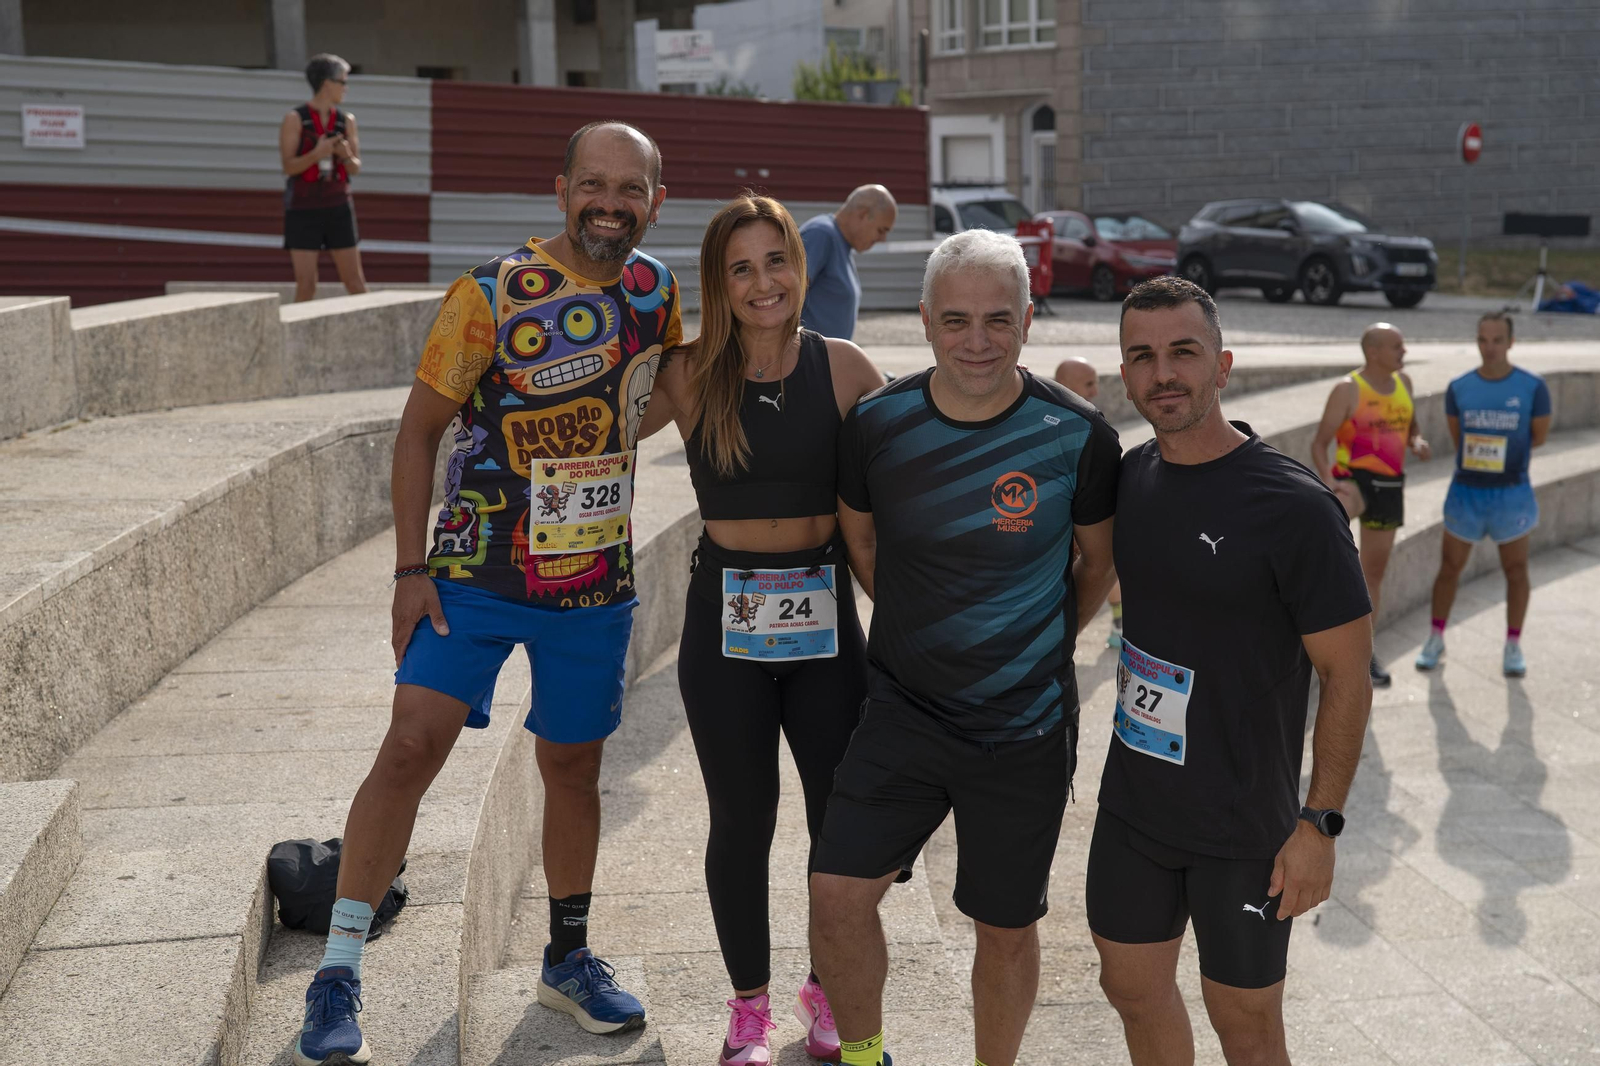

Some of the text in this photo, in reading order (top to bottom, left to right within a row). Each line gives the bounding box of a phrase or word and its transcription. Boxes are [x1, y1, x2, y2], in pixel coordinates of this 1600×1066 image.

[555, 404, 602, 441] BAD
[597, 454, 629, 467] POPULAR
[569, 467, 611, 479] DO PULPO
[580, 482, 620, 510] 328
[578, 511, 592, 519] OSCAR
[992, 517, 1034, 527] MERCERIA
[997, 524, 1028, 532] MUSKO
[758, 581, 804, 590] DO PULPO
[779, 597, 813, 620] 24
[728, 646, 749, 654] GADIS
[1137, 664, 1158, 680] PULPO
[1135, 684, 1163, 713] 27
